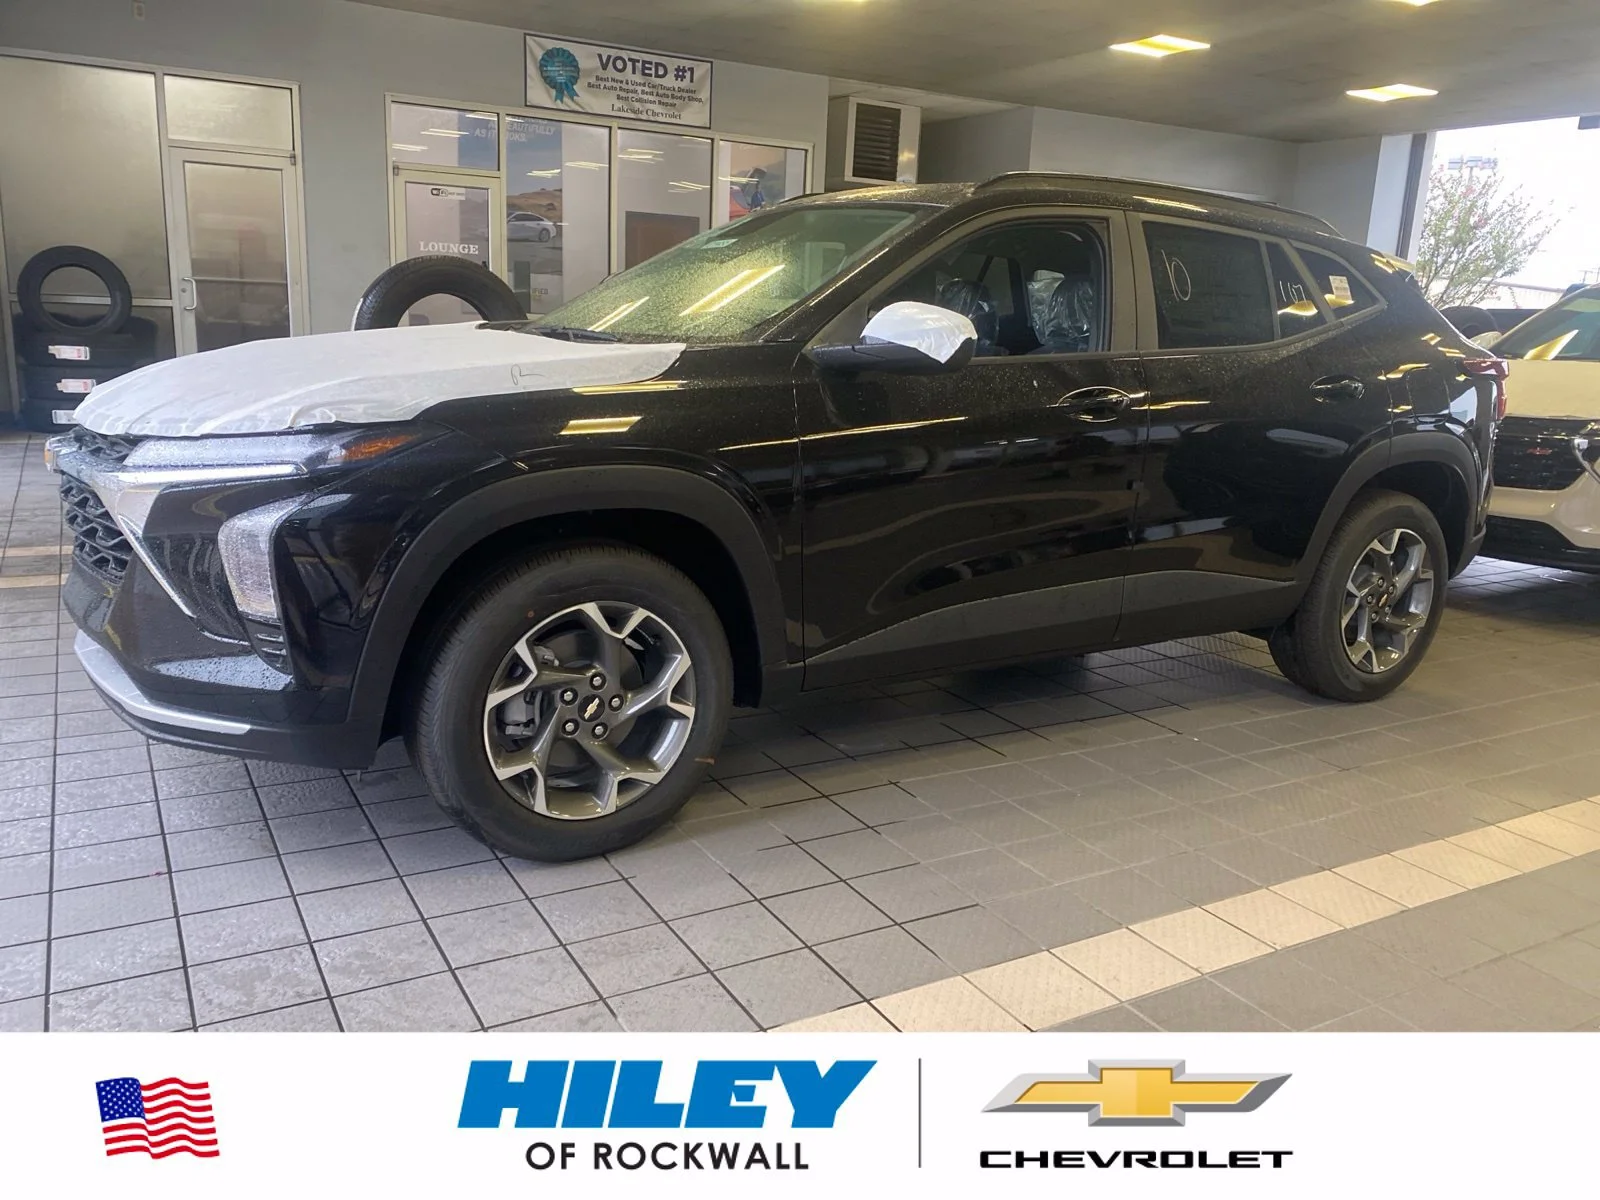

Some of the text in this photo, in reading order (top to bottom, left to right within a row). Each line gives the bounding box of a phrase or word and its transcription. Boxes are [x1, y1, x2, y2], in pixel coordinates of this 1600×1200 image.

[597, 53, 668, 78] VOTED
[674, 65, 694, 83] #1
[587, 82, 601, 90] Best
[641, 89, 655, 97] Best
[655, 91, 670, 99] Auto
[671, 93, 686, 102] Body
[647, 82, 676, 92] Car/Truck
[677, 86, 697, 95] Dealer
[630, 97, 656, 105] Collision
[657, 100, 677, 108] Repair
[611, 103, 682, 120] Lakeside Chevrolet
[507, 122, 555, 136] EAUTIFULLY
[419, 241, 479, 255] LOUNGE
